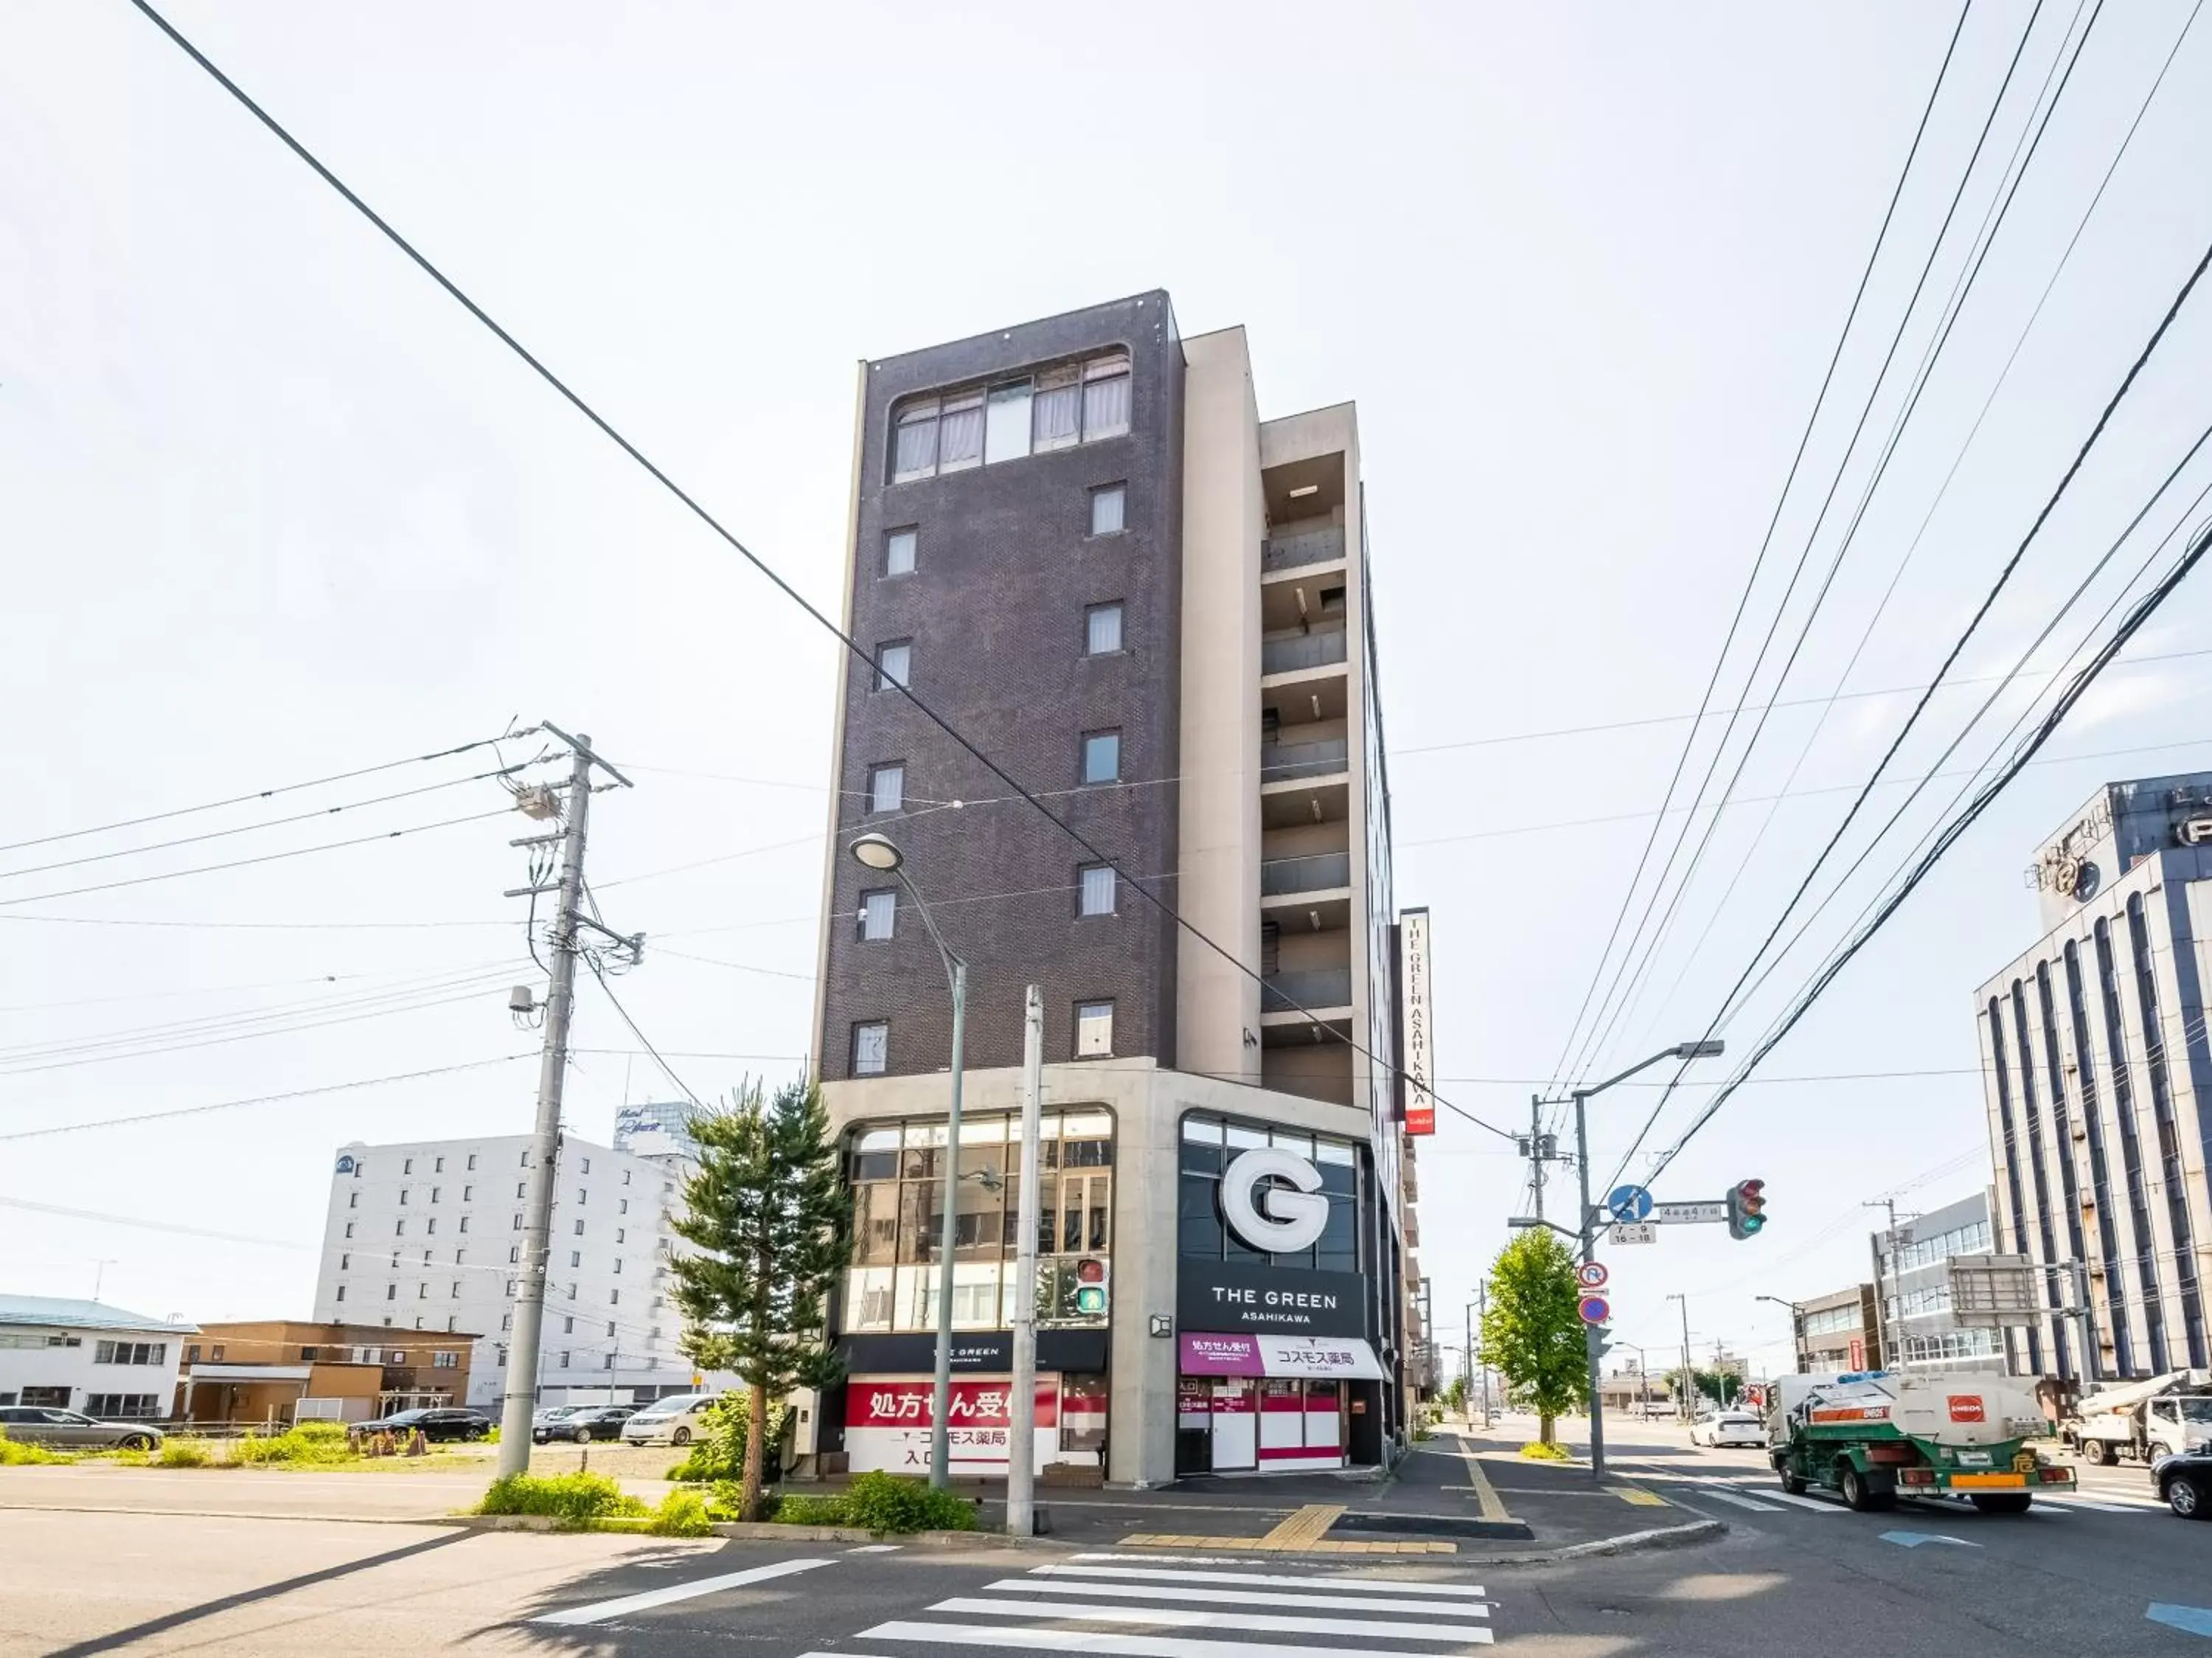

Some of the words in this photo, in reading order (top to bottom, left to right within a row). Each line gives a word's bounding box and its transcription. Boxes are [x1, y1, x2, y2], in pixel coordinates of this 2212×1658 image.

[1409, 919, 1419, 950] THE
[1411, 953, 1421, 1005] GREEN
[1411, 1008, 1425, 1104] ASAHIKAWA
[1222, 1148, 1329, 1252] G
[1212, 1287, 1256, 1303] THE
[1265, 1291, 1336, 1309] GREEN
[1242, 1312, 1310, 1324] ASAHIKAWA
[1277, 1350, 1354, 1365] コスモス薬局
[919, 1432, 1006, 1446] コモス薬局
